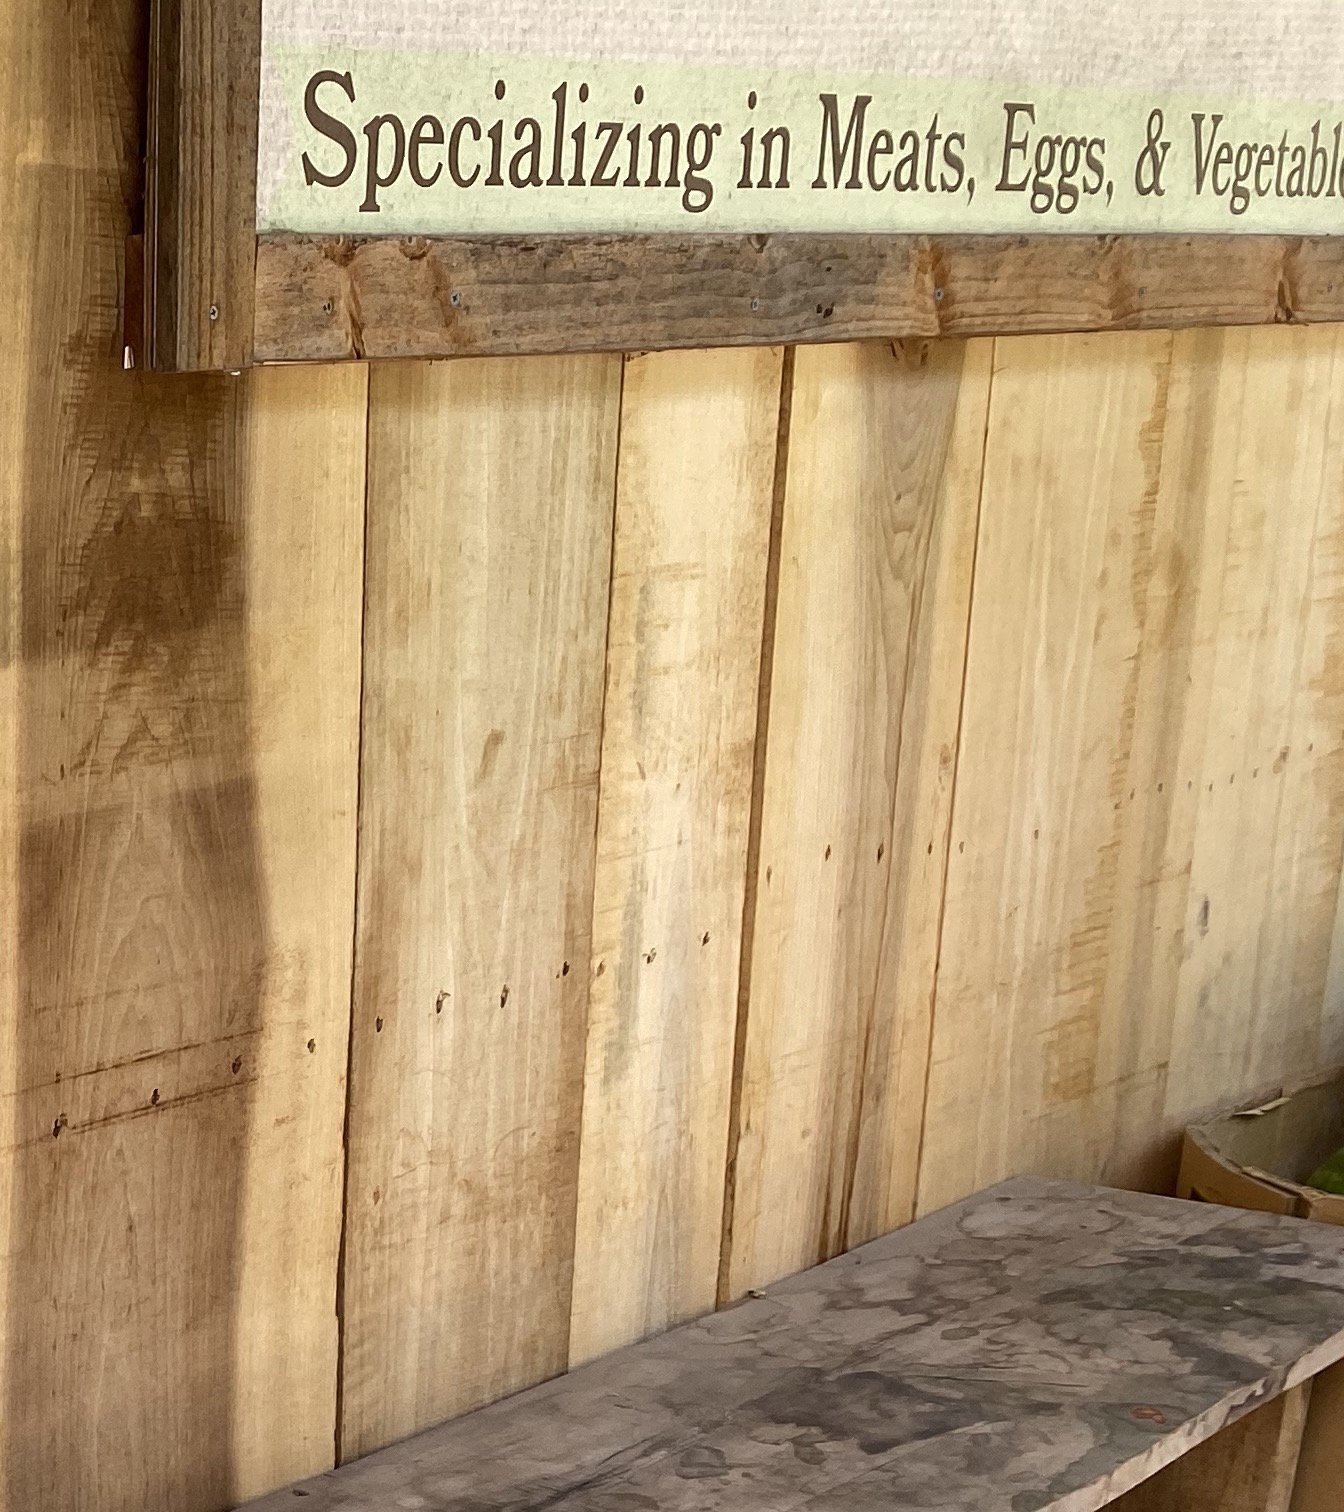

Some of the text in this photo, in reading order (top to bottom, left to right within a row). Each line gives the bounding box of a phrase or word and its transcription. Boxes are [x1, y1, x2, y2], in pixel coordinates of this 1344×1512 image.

[302, 70, 721, 213] Specializing
[737, 91, 790, 189] in
[811, 93, 976, 207] Meats,
[995, 102, 1113, 214] Eggs,
[1135, 108, 1171, 196] &
